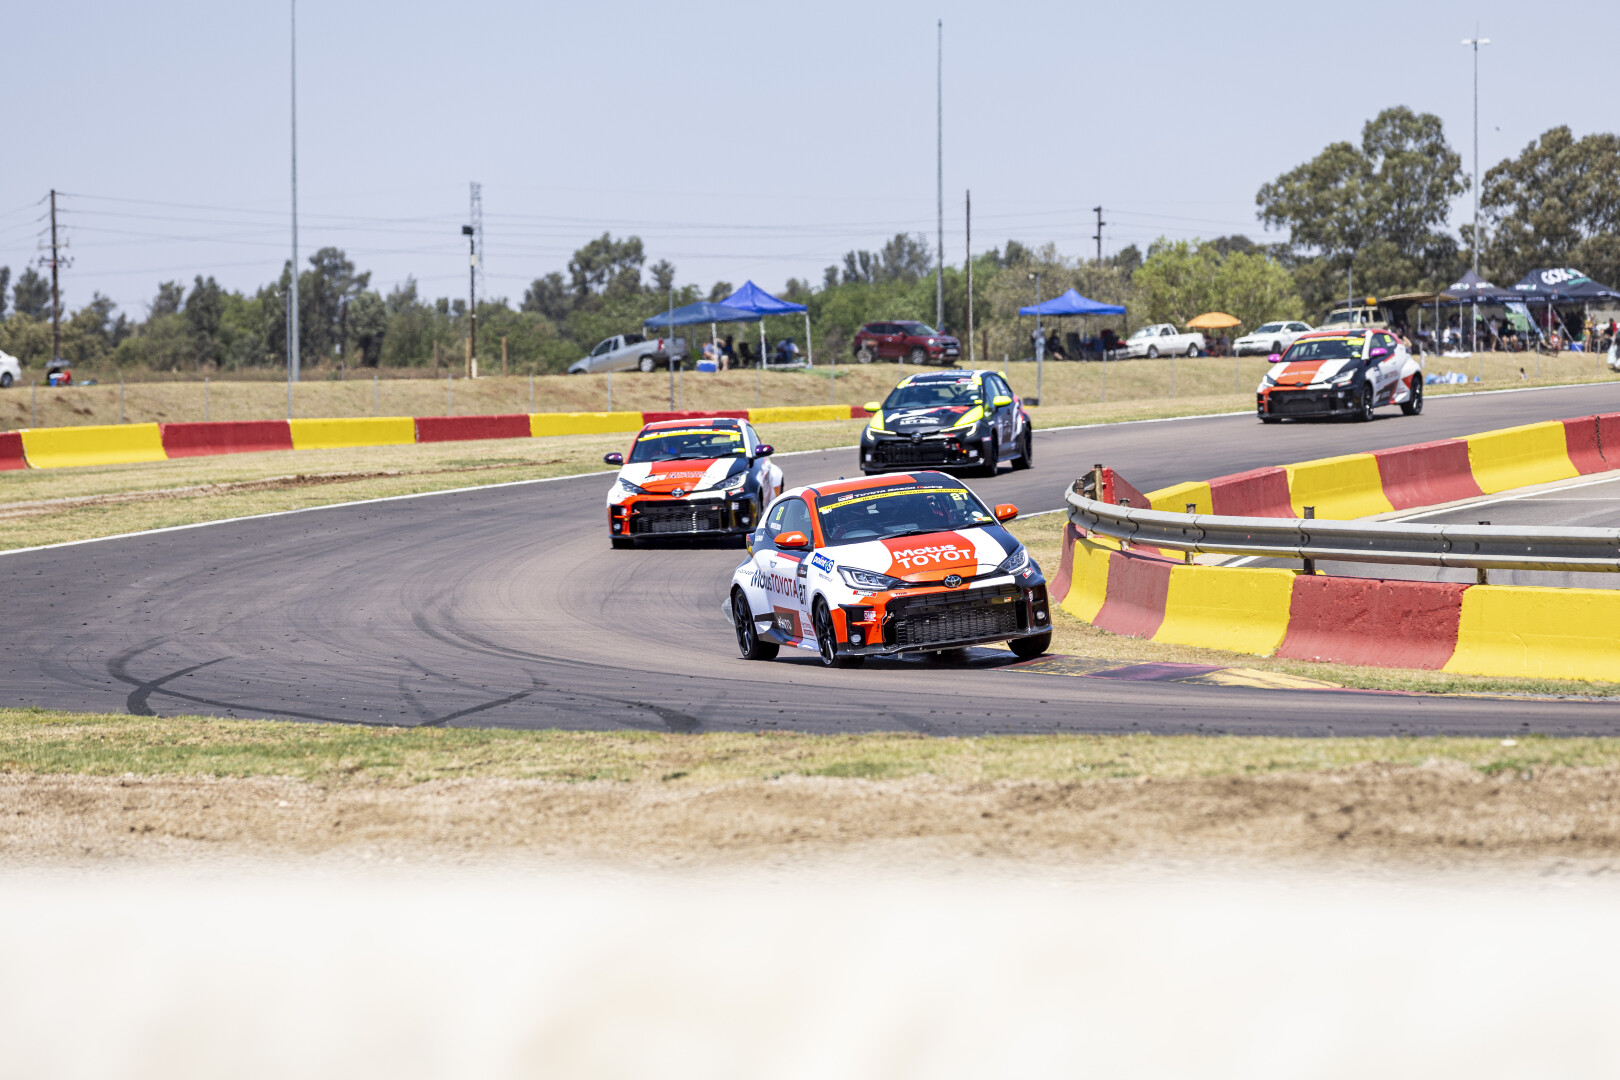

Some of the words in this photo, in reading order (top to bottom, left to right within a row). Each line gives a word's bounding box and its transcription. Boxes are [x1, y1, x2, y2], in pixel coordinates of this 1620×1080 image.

[950, 492, 968, 501] 27
[893, 544, 957, 560] Motus
[897, 549, 973, 569] TOYOT
[770, 573, 799, 598] TOYOTA
